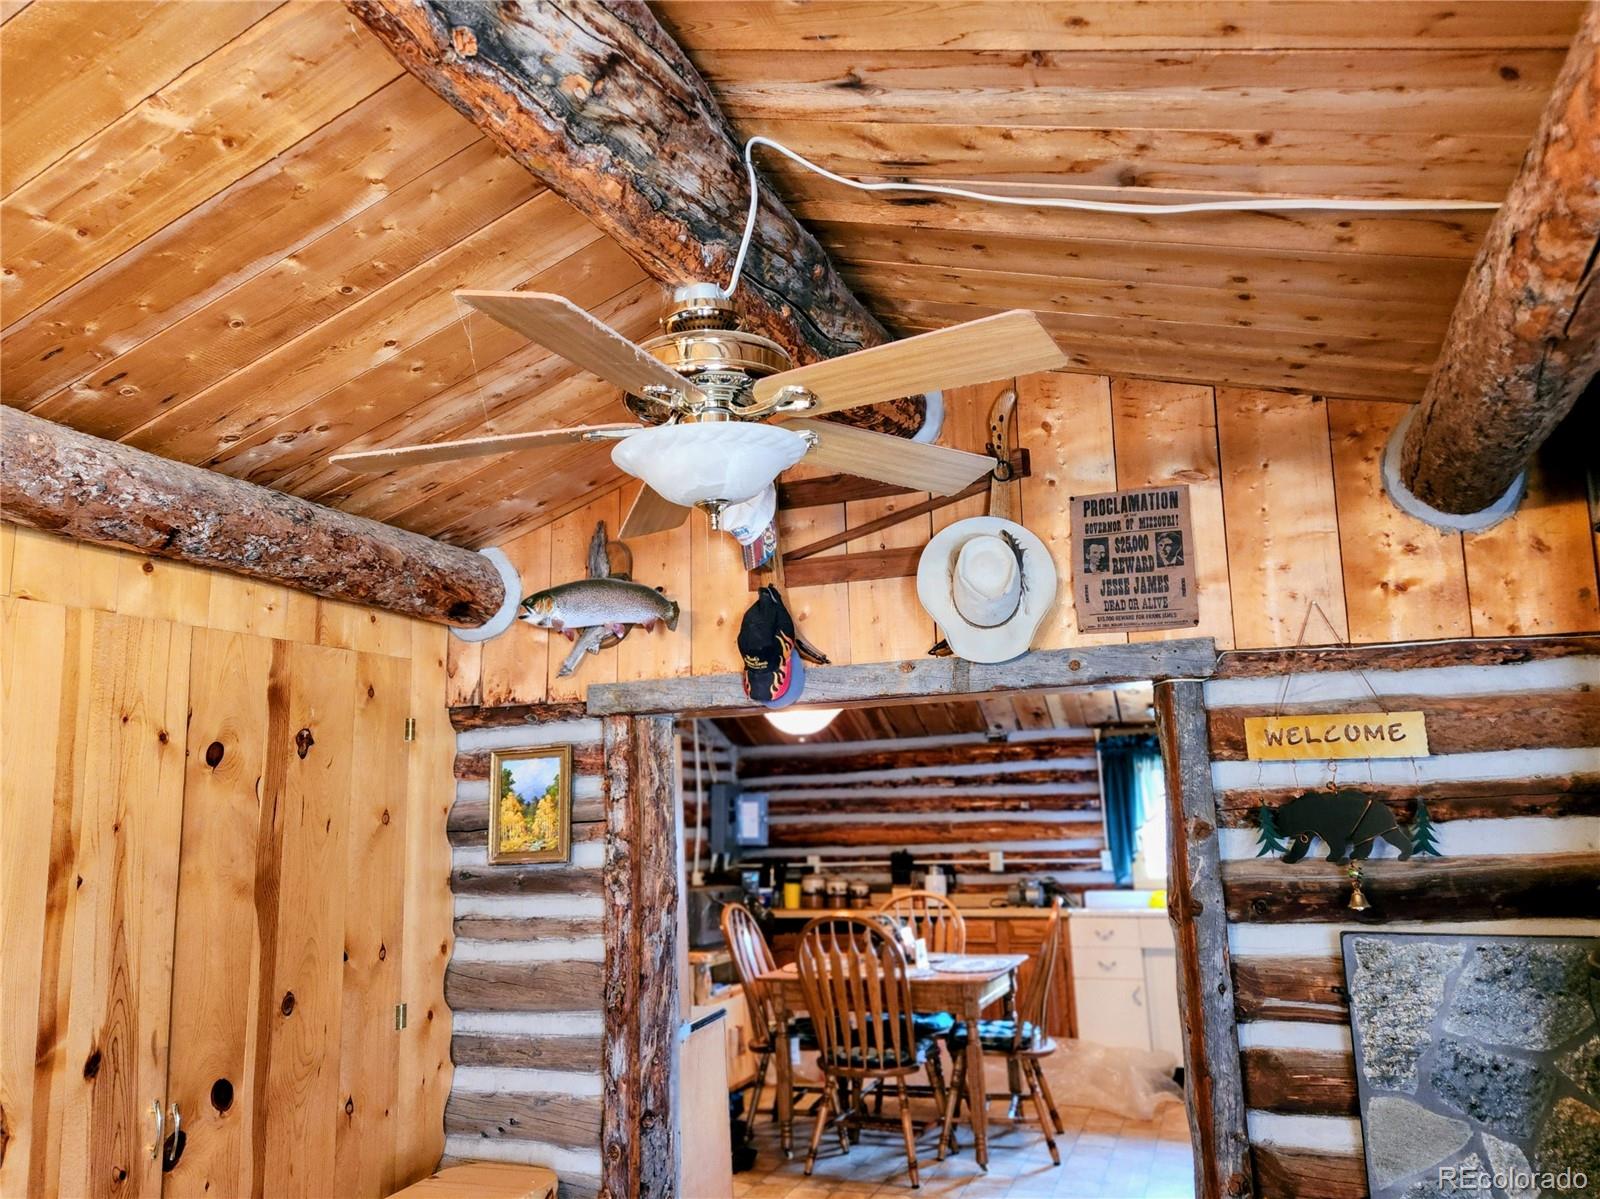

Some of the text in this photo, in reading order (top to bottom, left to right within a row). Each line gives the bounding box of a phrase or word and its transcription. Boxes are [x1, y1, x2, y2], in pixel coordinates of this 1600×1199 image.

[1083, 491, 1179, 517] PROCLAMATION
[1085, 520, 1121, 534] GOVERNOR
[1126, 518, 1134, 530] OF
[1115, 534, 1149, 554] $25,000
[1112, 555, 1154, 575] REWARD
[1100, 577, 1130, 597] JESSE
[1134, 575, 1169, 596] JAMES
[1104, 596, 1169, 612] DEAD OR ALIVE
[1264, 722, 1407, 747] WELCOME
